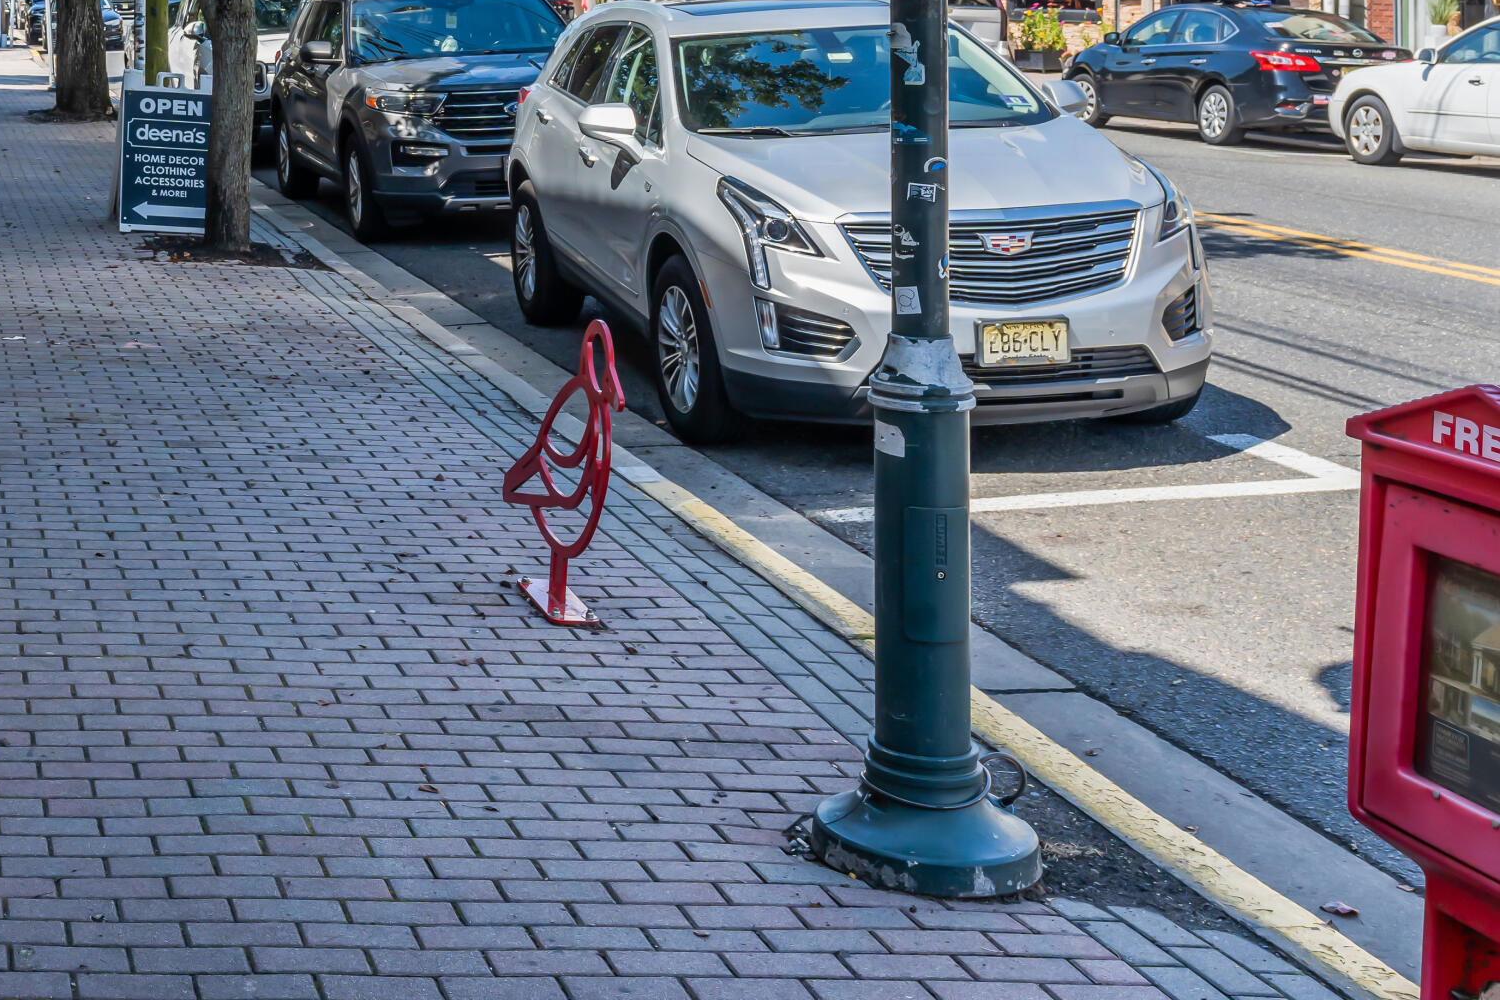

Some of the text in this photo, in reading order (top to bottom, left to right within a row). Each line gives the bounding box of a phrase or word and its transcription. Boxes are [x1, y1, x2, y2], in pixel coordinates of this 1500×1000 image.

[139, 97, 203, 117] OPEN
[136, 123, 206, 144] deena's
[134, 153, 205, 166] HOME DECOR
[143, 165, 197, 177] CLOTHING
[134, 176, 205, 188] ACCESSORIES
[159, 189, 188, 198] MORE!
